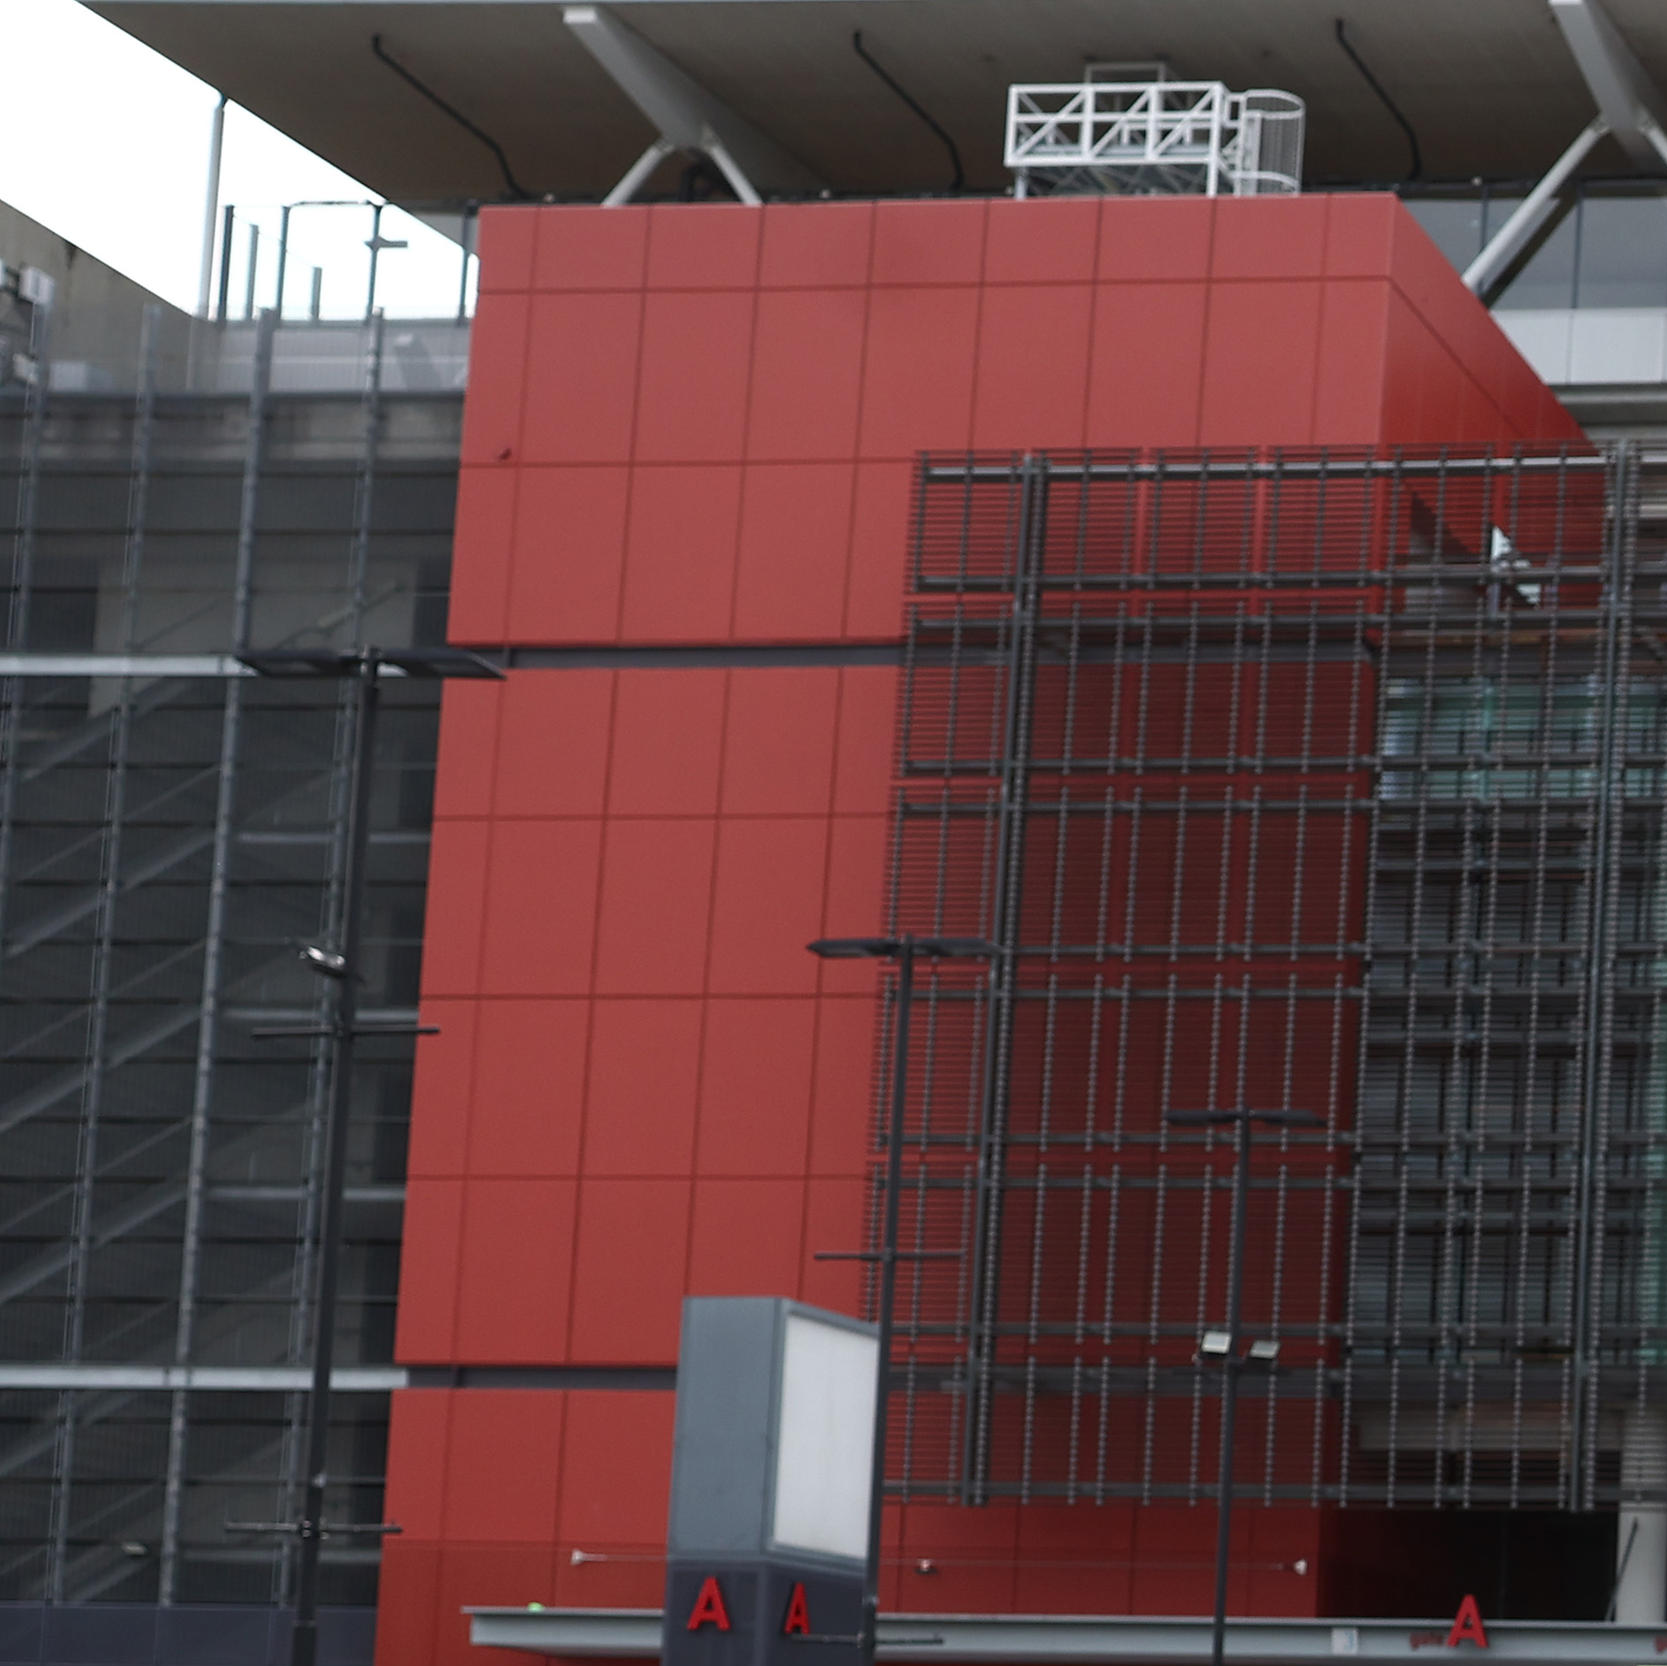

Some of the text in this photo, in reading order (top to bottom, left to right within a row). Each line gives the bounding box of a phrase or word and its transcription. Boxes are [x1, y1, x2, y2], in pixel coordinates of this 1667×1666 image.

[686, 1576, 731, 1631] A
[784, 1581, 811, 1634] A
[1446, 1594, 1489, 1648] A
